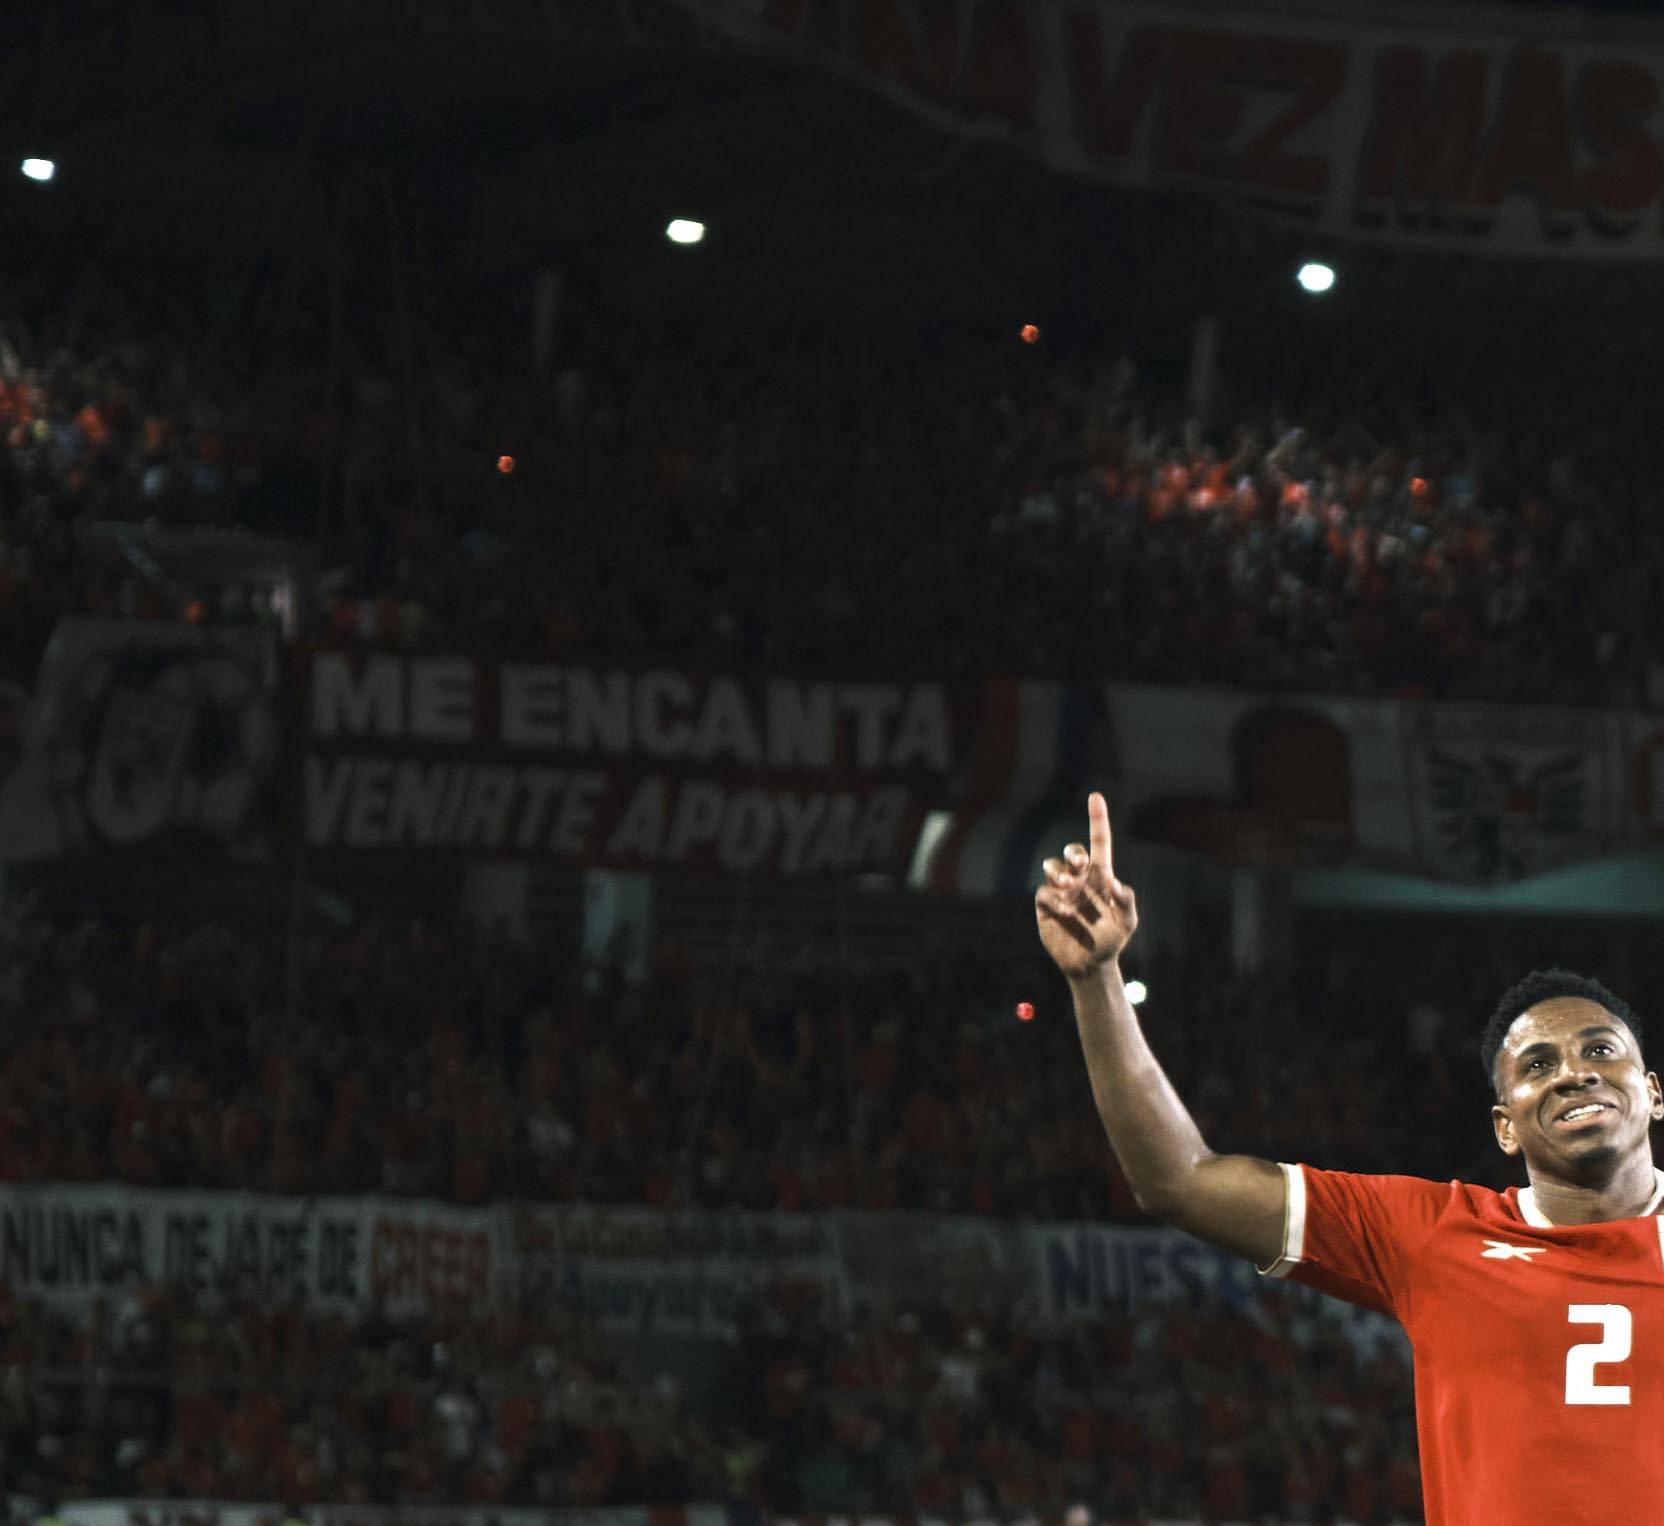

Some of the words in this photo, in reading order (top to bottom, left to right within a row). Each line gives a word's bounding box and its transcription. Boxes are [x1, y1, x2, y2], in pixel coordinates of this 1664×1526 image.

[1068, 10, 1350, 205] VEZ
[312, 654, 476, 740] ME
[500, 664, 953, 771] ENCANTA
[302, 757, 593, 850] VENIRTE
[606, 771, 910, 876] APOYAR
[4, 1203, 146, 1284] NUNCA
[318, 1219, 359, 1298] DE
[1565, 1304, 1632, 1405] 2
